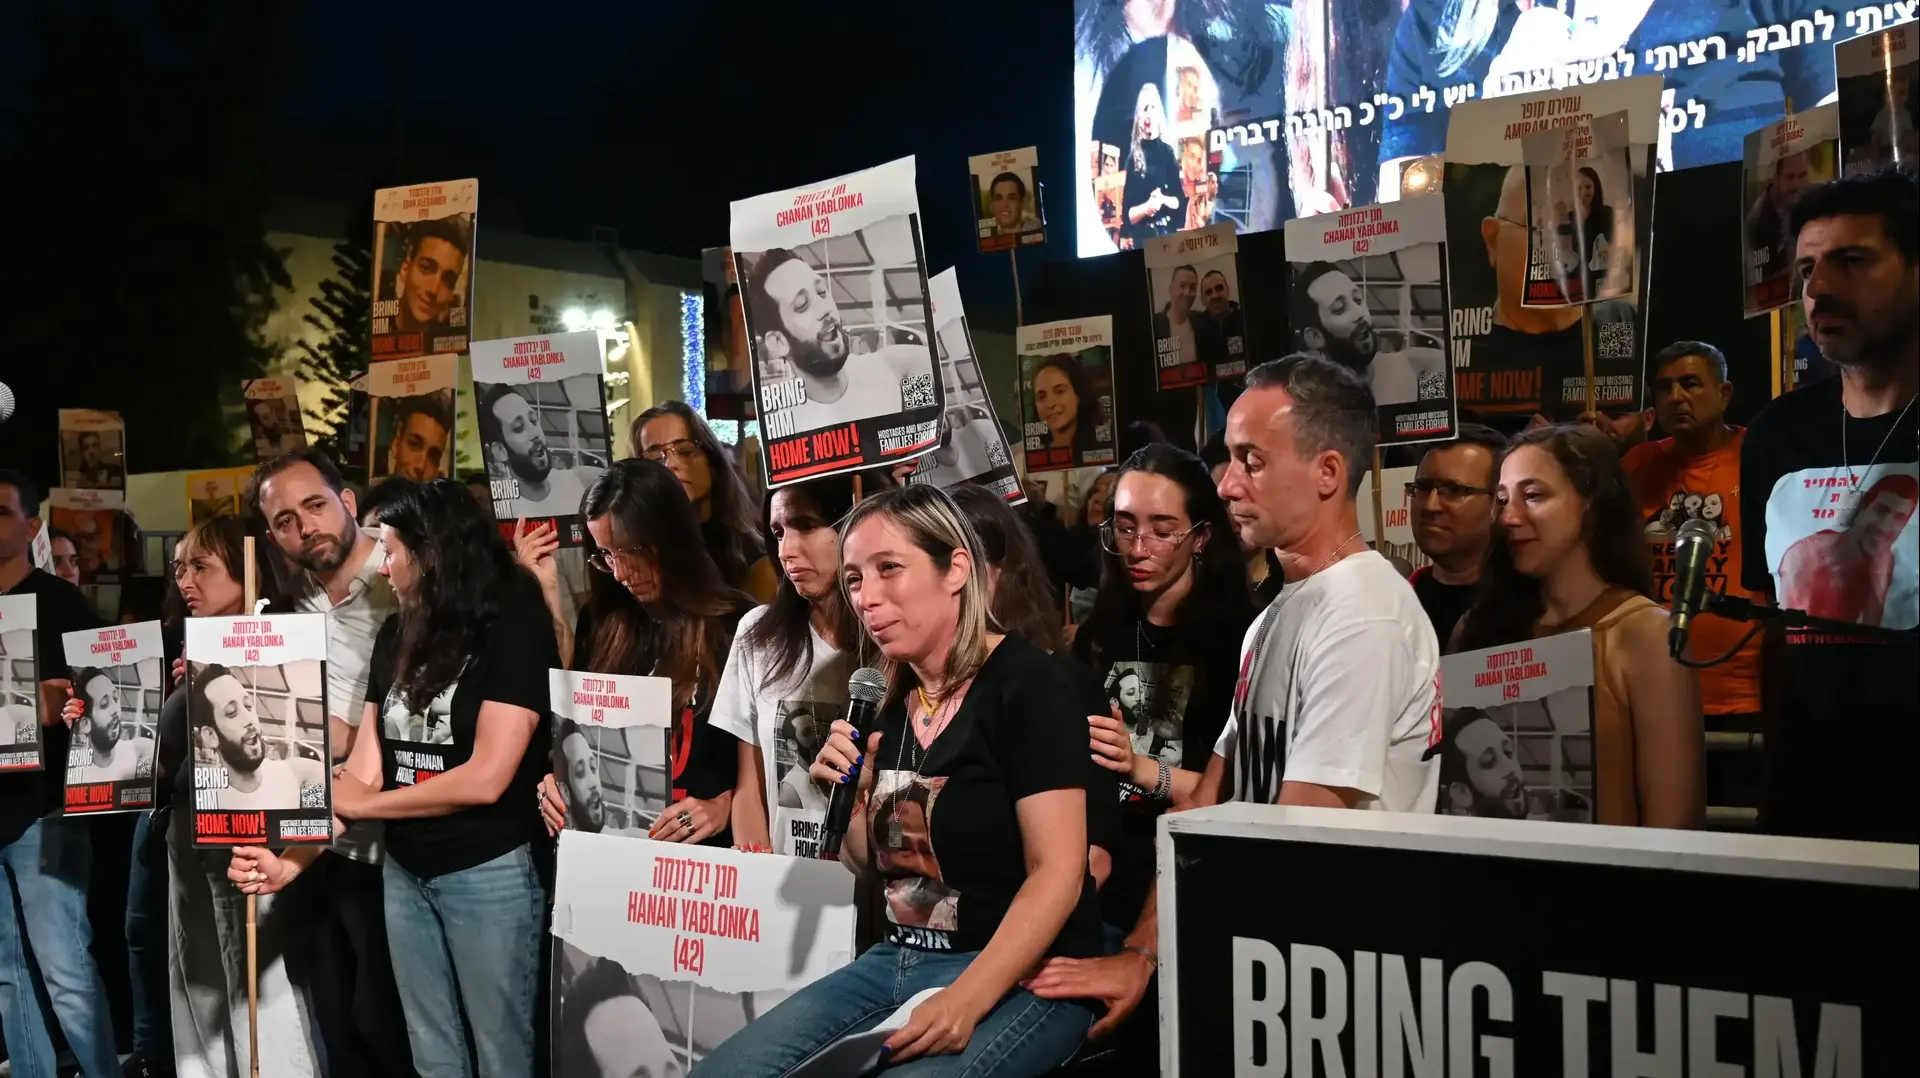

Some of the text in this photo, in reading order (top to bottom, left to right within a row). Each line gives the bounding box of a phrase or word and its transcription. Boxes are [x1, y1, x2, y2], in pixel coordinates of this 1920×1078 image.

[1736, 9, 1835, 63] לחבק,
[1645, 35, 1727, 72] רציתי
[1412, 85, 1436, 113] לי
[1210, 119, 1280, 153] דברים
[776, 192, 864, 228] CHANAN YABLONKA
[1338, 208, 1382, 228] חנן יבלונקה
[811, 216, 831, 238] (42)
[1323, 220, 1399, 245] CHANAN YABLONKA
[1205, 233, 1218, 247] אלי
[1352, 238, 1369, 255] (42)
[1530, 264, 1551, 281] HER
[373, 300, 400, 318] BRING
[372, 318, 389, 335] HIM
[1452, 306, 1493, 337] RING
[1157, 336, 1181, 353] BRING
[503, 351, 565, 369] CHANAN YABLONKA
[1158, 351, 1181, 368] THEM
[527, 366, 541, 380] (42)
[1490, 365, 1542, 400] NOW!
[1606, 374, 1633, 386] MISSING
[761, 378, 806, 413] BRING
[1602, 384, 1634, 400] FORUM
[764, 409, 796, 440] HIM
[877, 419, 938, 440] HOSTAGES AND MISSING
[1024, 421, 1049, 437] BRING
[1396, 417, 1449, 434] FAMILIES FORUM
[769, 422, 861, 471] HOME NOW!
[879, 427, 938, 452] FAMILIES FORUM
[909, 451, 938, 475] RING
[490, 479, 520, 500] BRING
[493, 500, 513, 520] HIM
[1385, 508, 1408, 528] IAIR
[232, 621, 272, 636] חנן יבלונקה
[90, 638, 137, 654] CHANAN YABLONKA
[223, 634, 284, 649] HANAN YABLONKA
[110, 651, 122, 663] (42)
[245, 649, 260, 662] (42)
[1487, 647, 1533, 671] חנן יבלונקה
[1474, 661, 1548, 689] HANAN YABLONKA
[582, 678, 616, 694] חנן יבלונקה
[1502, 682, 1520, 701] (42)
[573, 690, 630, 710] CHANAN YABLONKA
[591, 708, 604, 723] (42)
[68, 749, 93, 767] BRING
[415, 752, 445, 771] HANAN
[66, 767, 84, 785] HIM
[194, 767, 229, 789] BRING
[396, 766, 415, 785] HOME
[65, 786, 88, 805] HOME
[90, 782, 114, 803] NOW!
[196, 789, 219, 810] HIM
[196, 810, 266, 835] HOME NOW!
[280, 826, 328, 837] FAMILIES FORUM
[791, 819, 819, 841] BRING
[795, 839, 818, 860] HOME
[652, 856, 739, 900] חנן יבלונקה
[627, 890, 761, 943] HANAN YABLONKA
[673, 934, 705, 977] (42)
[1232, 936, 1863, 1078] BRING THEM
